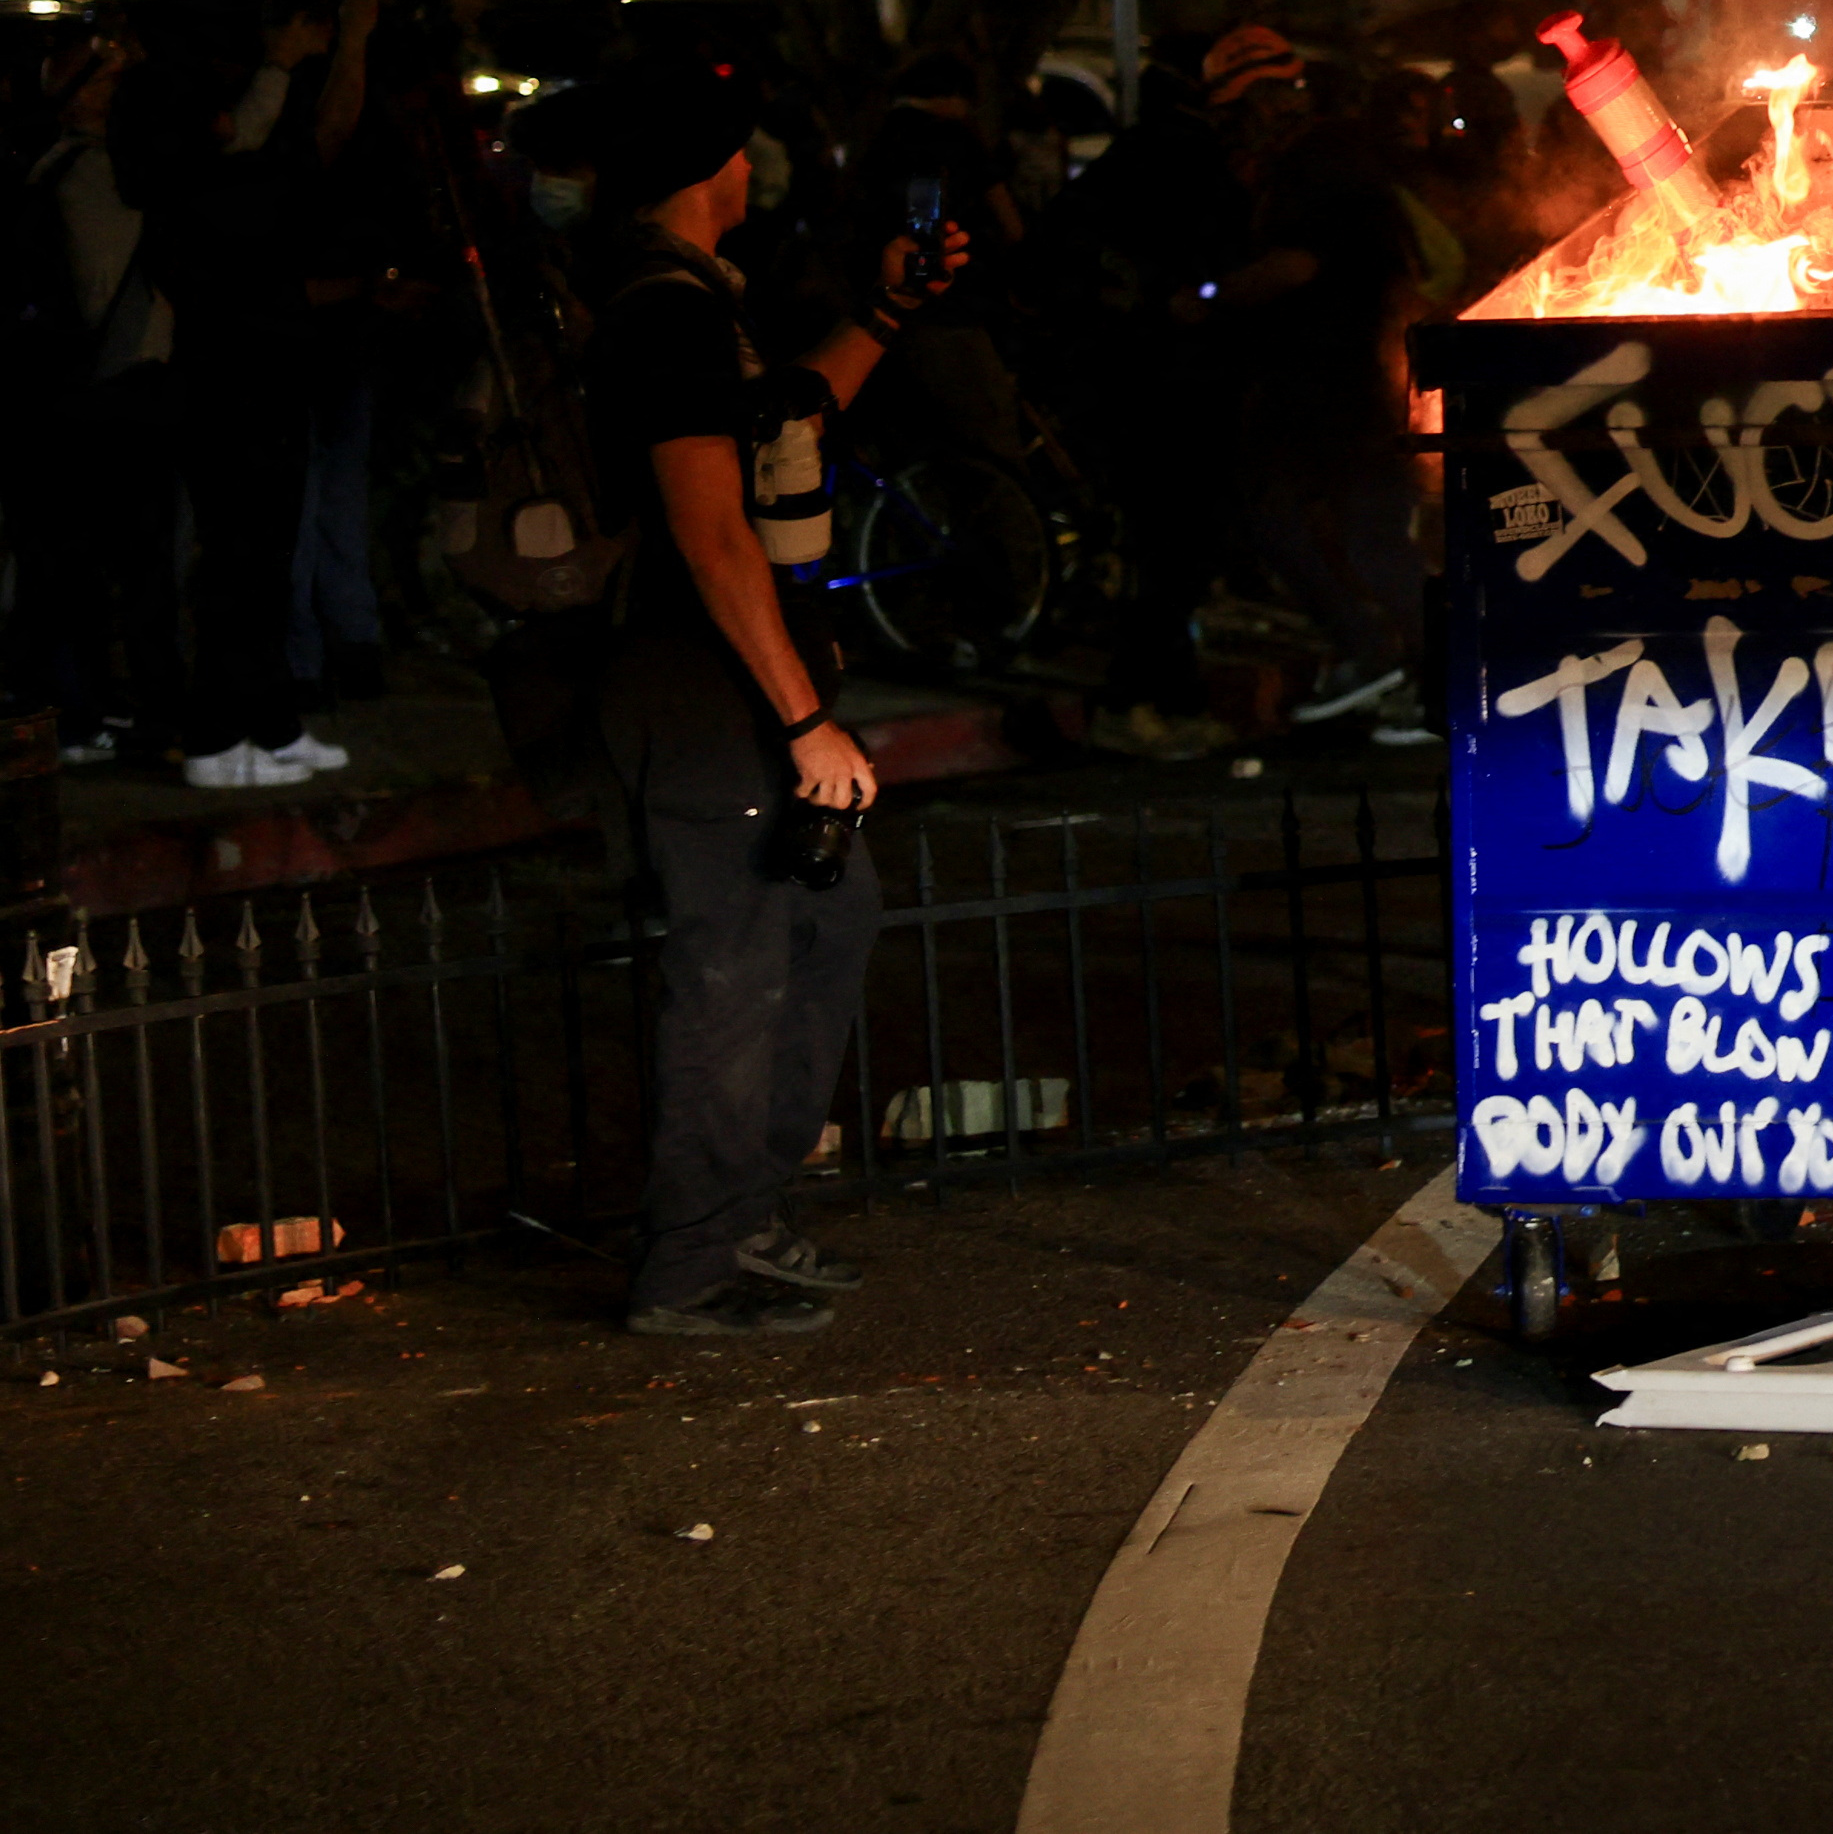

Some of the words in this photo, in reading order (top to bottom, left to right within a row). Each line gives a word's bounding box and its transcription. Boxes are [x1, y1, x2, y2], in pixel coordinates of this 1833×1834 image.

[1518, 910, 1829, 1022] HOLLOWS
[1480, 992, 1658, 1080] THAT
[1472, 1087, 1645, 1186] BODY
[1660, 1096, 1779, 1186] OUT
